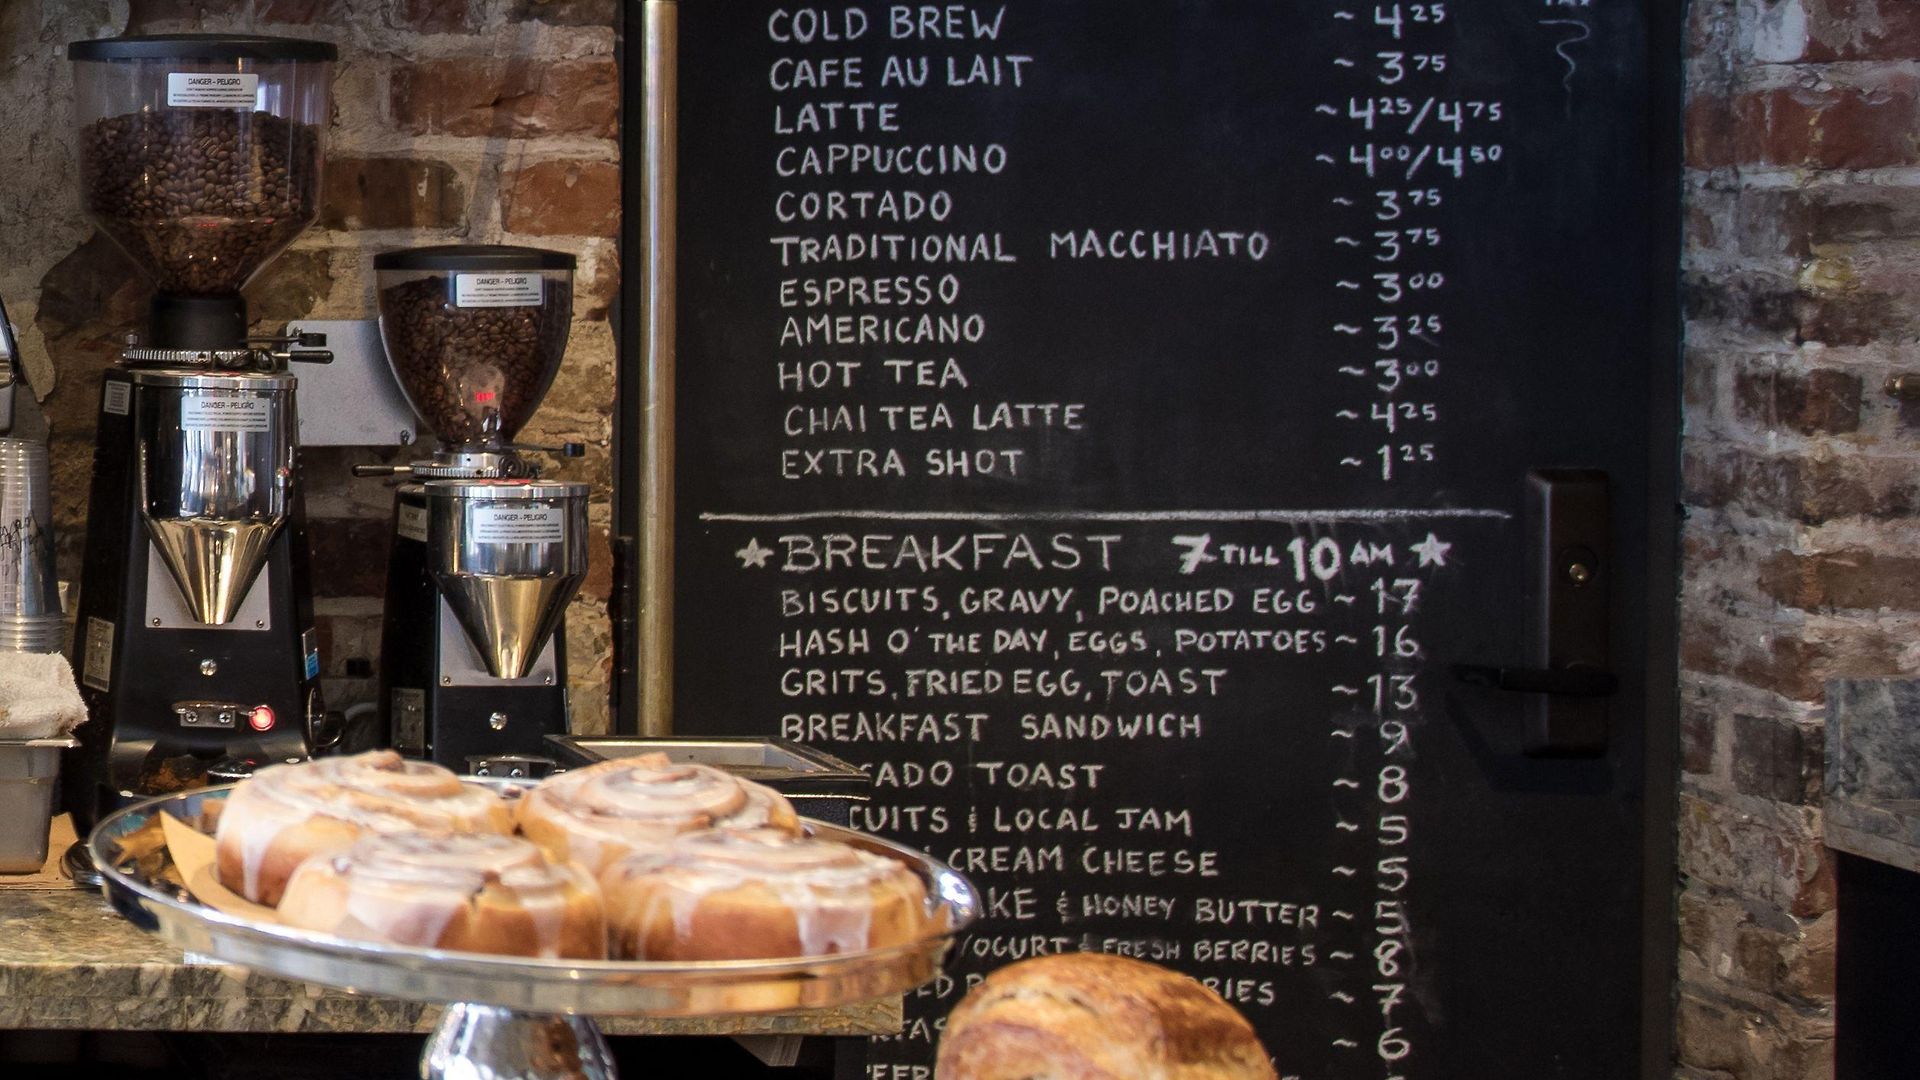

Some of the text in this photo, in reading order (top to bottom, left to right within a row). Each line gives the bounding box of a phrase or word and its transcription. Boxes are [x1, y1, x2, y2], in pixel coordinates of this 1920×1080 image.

[768, 7, 868, 44] COLD
[890, 4, 1006, 40] BREW
[216, 78, 241, 86] PELIGRO
[769, 57, 863, 91] CAFE
[881, 55, 929, 88] AU
[947, 54, 1033, 88] LAIT
[774, 101, 900, 135] LATTE
[775, 143, 1007, 177] CAPPUCCINO
[775, 189, 952, 223] CORTADO
[769, 232, 1017, 267] TRADITIONAL
[1050, 228, 1269, 261] MACCHIATO
[779, 273, 959, 308] ESPRESSO
[780, 313, 985, 347] AMERICANO
[777, 360, 862, 392] HOT
[883, 357, 968, 389] TEA
[201, 401, 254, 410] DANGER PELIGRO
[784, 404, 866, 436] CHAI
[879, 402, 953, 431] TEA
[972, 402, 1085, 432] LATTE
[782, 448, 906, 480] EXTRA
[925, 448, 1023, 477] SHOT
[778, 532, 1394, 582] BREAKFAST 7 TILL 10 AM
[1098, 585, 1234, 615] POACHED
[1252, 587, 1316, 614] EGG
[1370, 577, 1421, 615] 17
[779, 628, 870, 658] HASH
[927, 632, 981, 654] THE
[1174, 628, 1326, 654] POTATOES
[1372, 624, 1420, 658] 16
[904, 668, 1003, 697] FRIED
[1099, 667, 1227, 697] TOAST
[1367, 673, 1418, 711] 13
[781, 711, 1409, 755] BREAKFAST SANDWICH 9
[975, 761, 1104, 790] TOAST
[1377, 765, 1409, 804] 8
[994, 806, 1099, 833] LOCAL
[1115, 807, 1192, 837] JAM
[1377, 815, 1408, 846] 5
[947, 846, 1409, 892] CREAM CHEESE 5
[1082, 893, 1176, 920] HONEY
[1194, 898, 1319, 928] BUTTER
[1374, 900, 1410, 935] 5
[1101, 936, 1182, 961] FRESH
[1193, 939, 1316, 966] BERRIES
[1373, 939, 1403, 977] 8
[1371, 983, 1405, 1016] 7
[1377, 1027, 1411, 1061] 6
